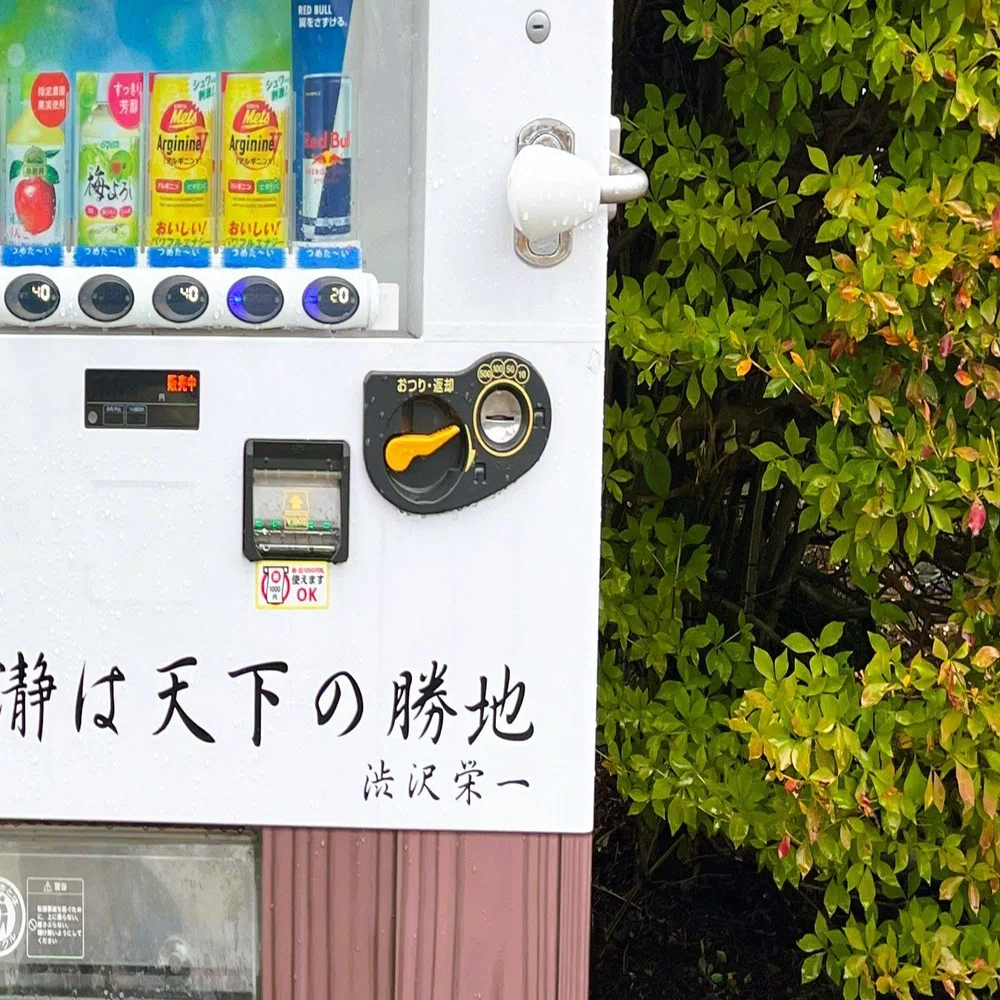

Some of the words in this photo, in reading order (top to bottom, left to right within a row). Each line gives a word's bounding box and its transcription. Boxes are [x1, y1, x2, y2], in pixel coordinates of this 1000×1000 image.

[298, 5, 311, 16] RED
[314, 5, 332, 16] BULL
[113, 81, 142, 96] すっきり
[170, 108, 197, 127] Mets
[242, 108, 270, 127] Mets
[157, 133, 202, 154] Arginine
[229, 133, 275, 154] Arginine
[304, 131, 328, 147] Red
[84, 166, 133, 202] 梅よろし
[167, 374, 196, 392] 販売中
[397, 378, 454, 393] おつり・返却
[292, 575, 324, 585] 使えます
[297, 588, 317, 602] OK
[363, 759, 530, 805] 渋沢栄一
